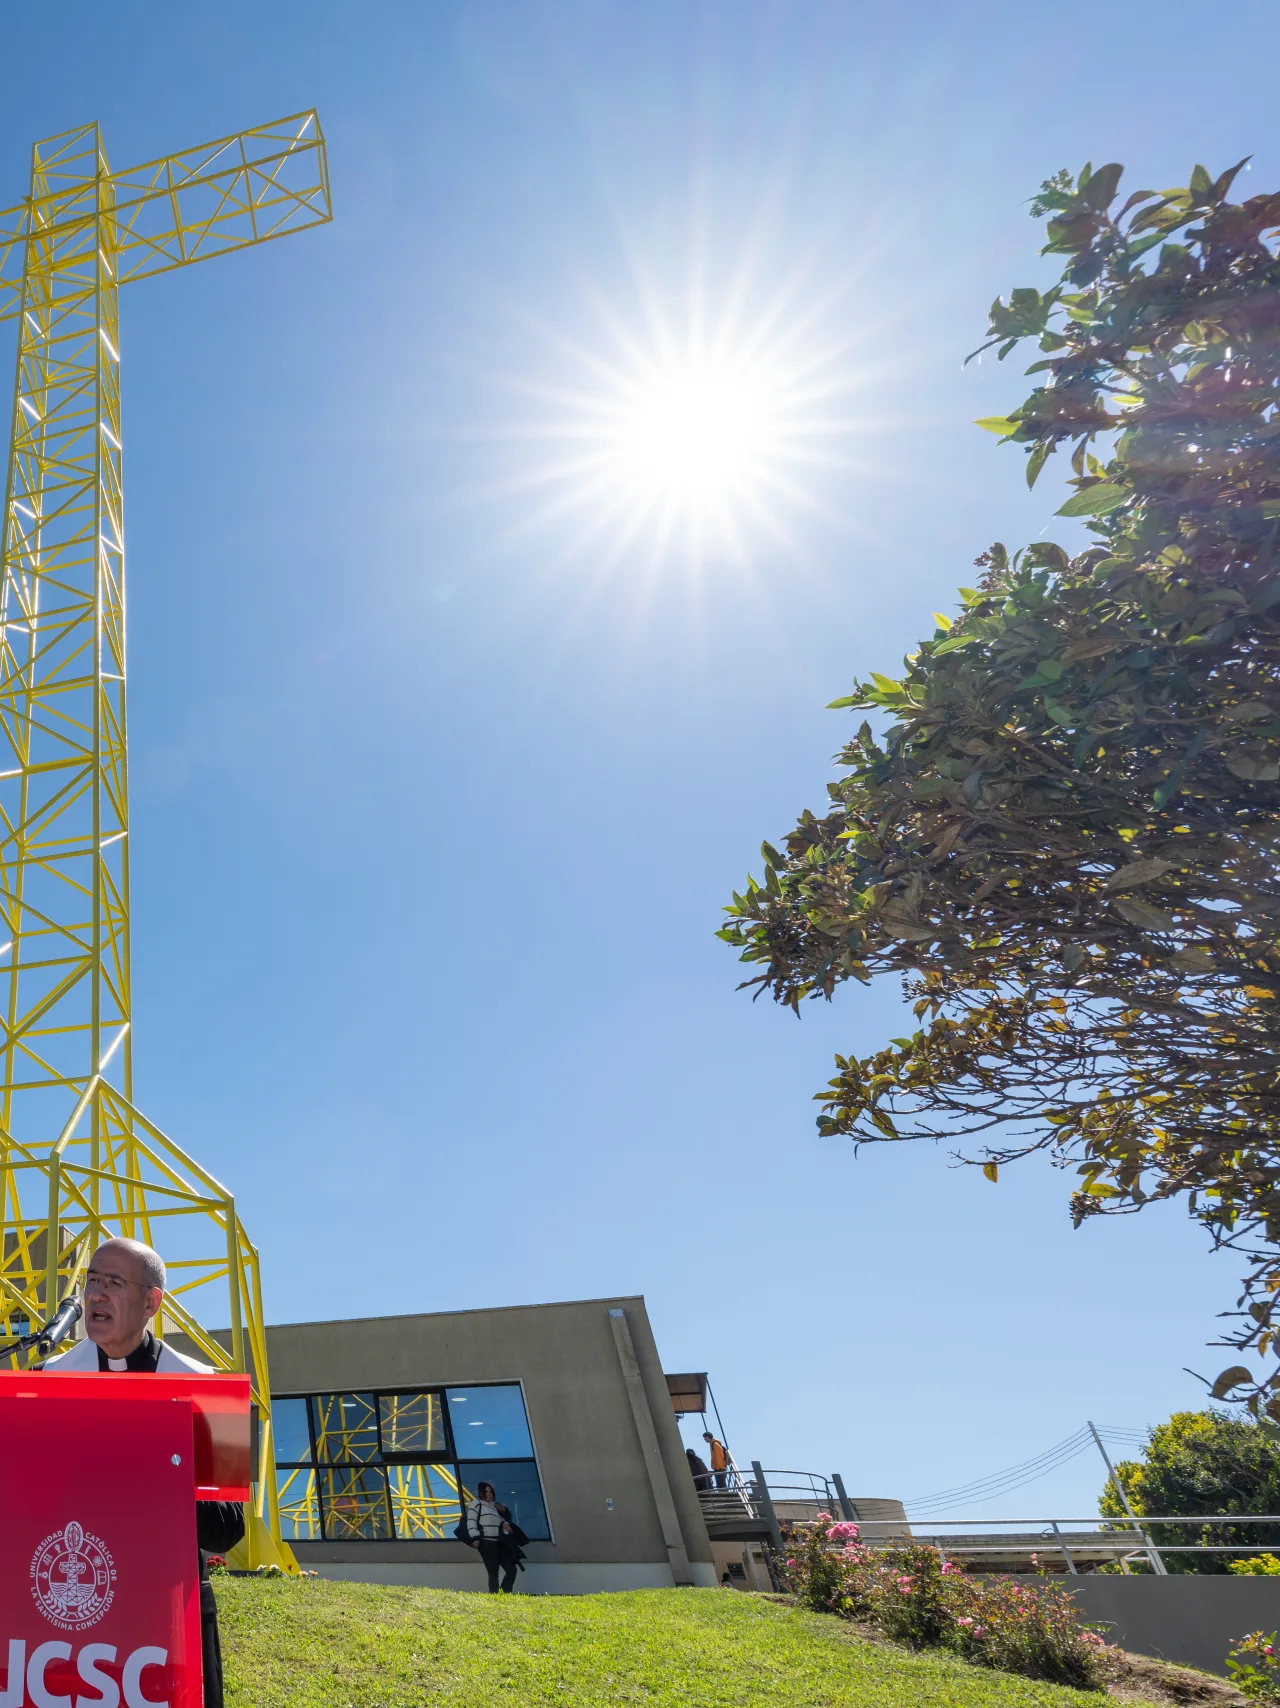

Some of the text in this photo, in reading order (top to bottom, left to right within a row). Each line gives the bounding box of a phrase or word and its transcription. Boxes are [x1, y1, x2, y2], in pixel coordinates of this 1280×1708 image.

[29, 1530, 117, 1581] UNIVERSIDAD CATÓLICA DE
[30, 1586, 115, 1631] LA SANTÍSIMA CONCEPCIÓN
